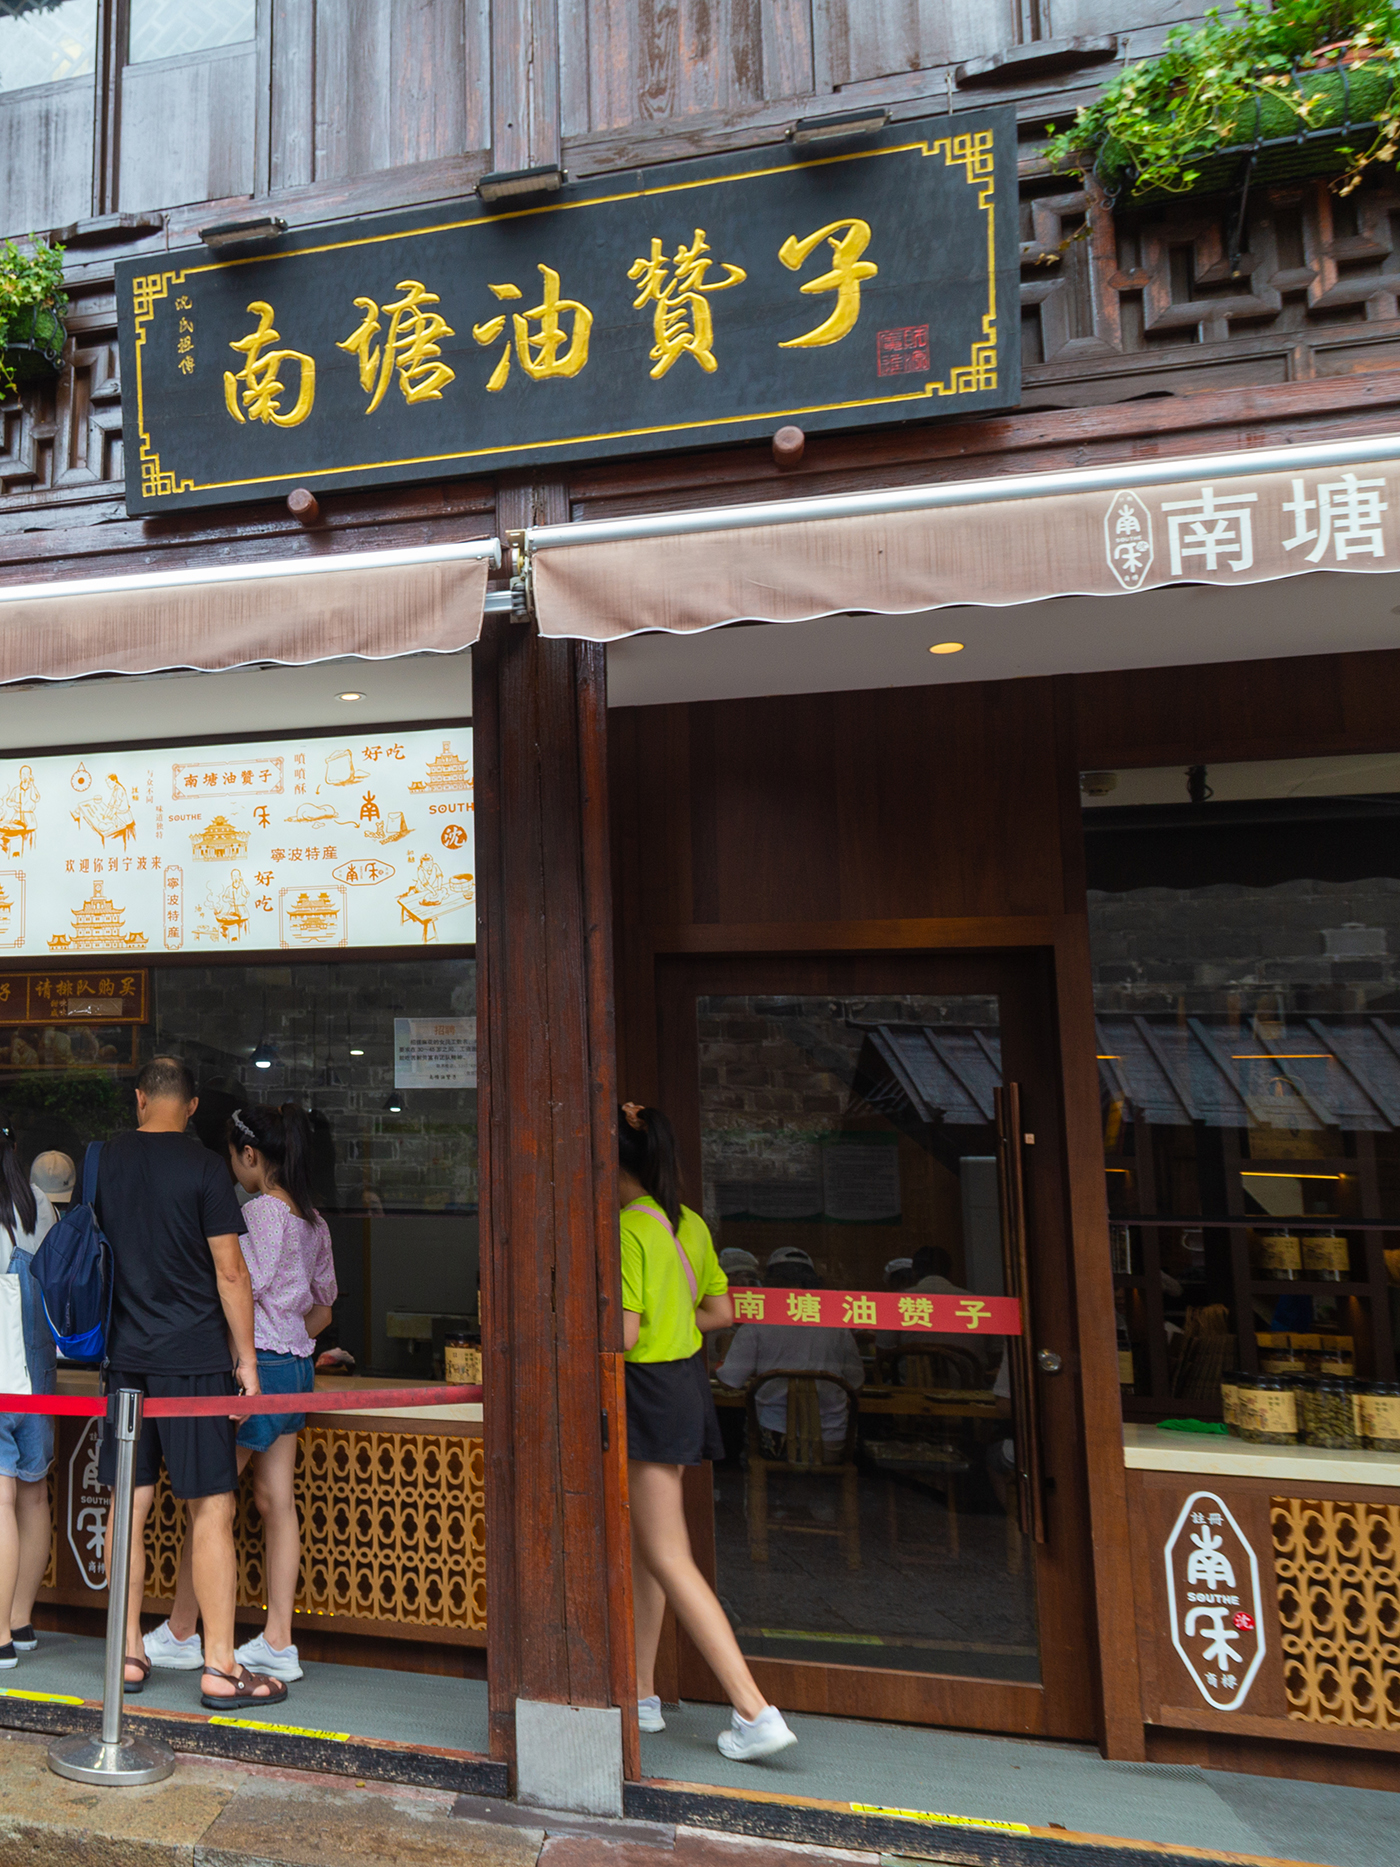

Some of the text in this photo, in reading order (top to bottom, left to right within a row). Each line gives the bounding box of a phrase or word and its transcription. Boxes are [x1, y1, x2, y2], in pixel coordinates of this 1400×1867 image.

[1160, 472, 1389, 576] 南塘
[361, 743, 406, 762] 好吃
[168, 813, 202, 822] SOUTHE
[64, 855, 162, 874] 欢迎你到宁波来
[253, 870, 275, 913] 好吃
[34, 976, 137, 1000] 请排队购买
[732, 1290, 992, 1330] 南塘油赞子
[80, 1495, 112, 1505] SOUTH
[1186, 1592, 1241, 1606] SOUTHE
